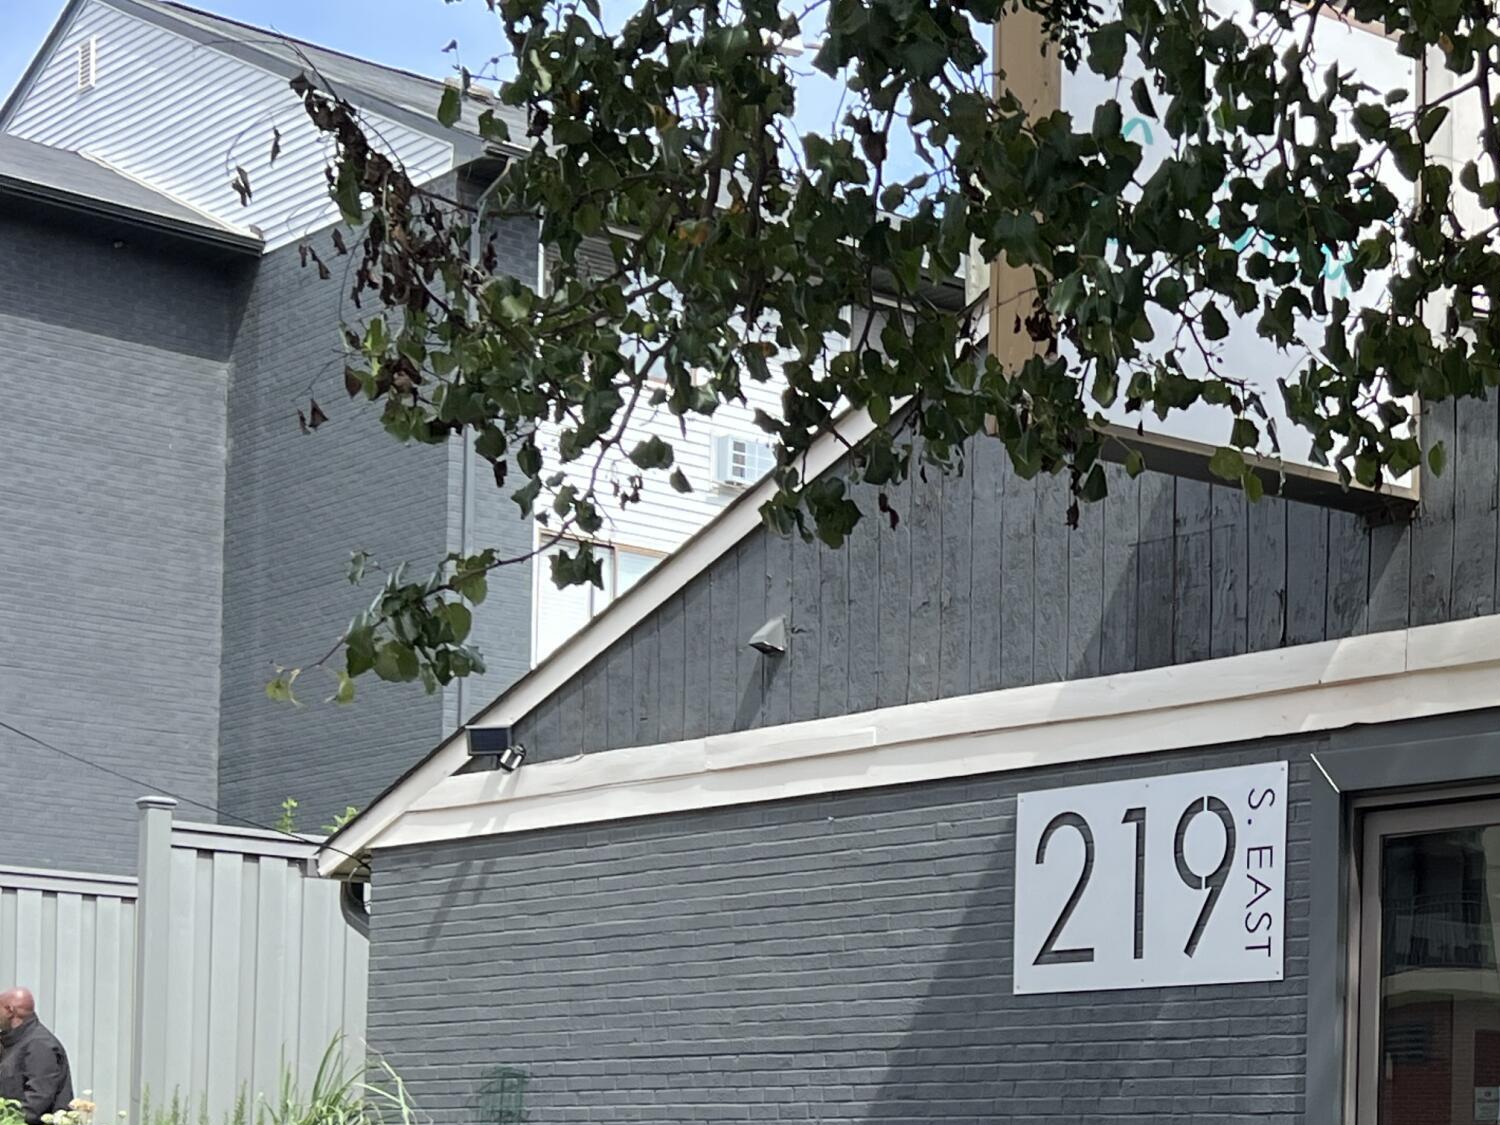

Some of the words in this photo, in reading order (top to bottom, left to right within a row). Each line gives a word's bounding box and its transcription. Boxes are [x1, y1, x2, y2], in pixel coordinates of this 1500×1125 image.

[1248, 787, 1275, 825] S.
[1032, 795, 1236, 965] 219
[1245, 845, 1273, 957] EAST
